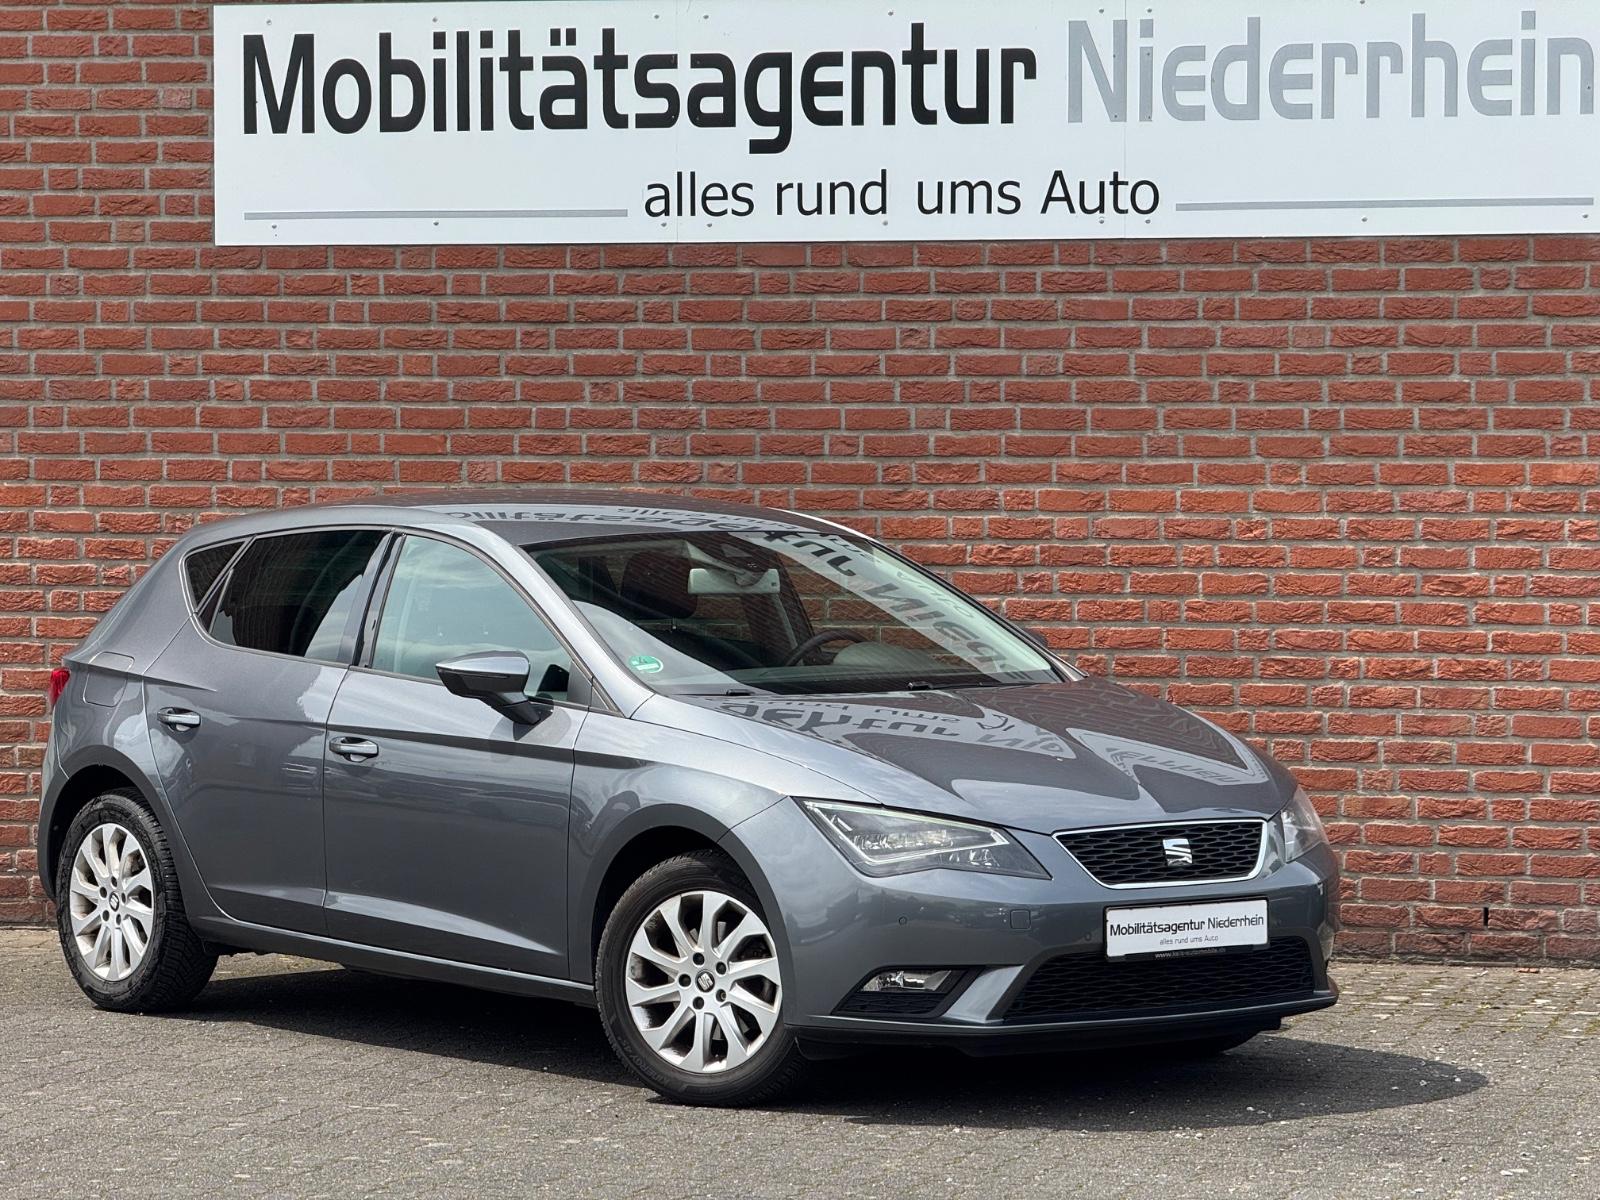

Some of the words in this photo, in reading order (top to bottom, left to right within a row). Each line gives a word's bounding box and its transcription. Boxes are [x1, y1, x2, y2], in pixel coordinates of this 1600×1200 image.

[243, 22, 1037, 154] Mobilitätsagentur
[1068, 10, 1595, 123] Niederrhein
[644, 170, 754, 217] alles
[776, 168, 887, 216] rund
[918, 179, 1021, 215] ums
[1041, 169, 1160, 215] Auto
[1110, 919, 1205, 936] Mobilitätsagentur
[1207, 914, 1264, 930] Niederrhein
[1175, 936, 1188, 944] rund
